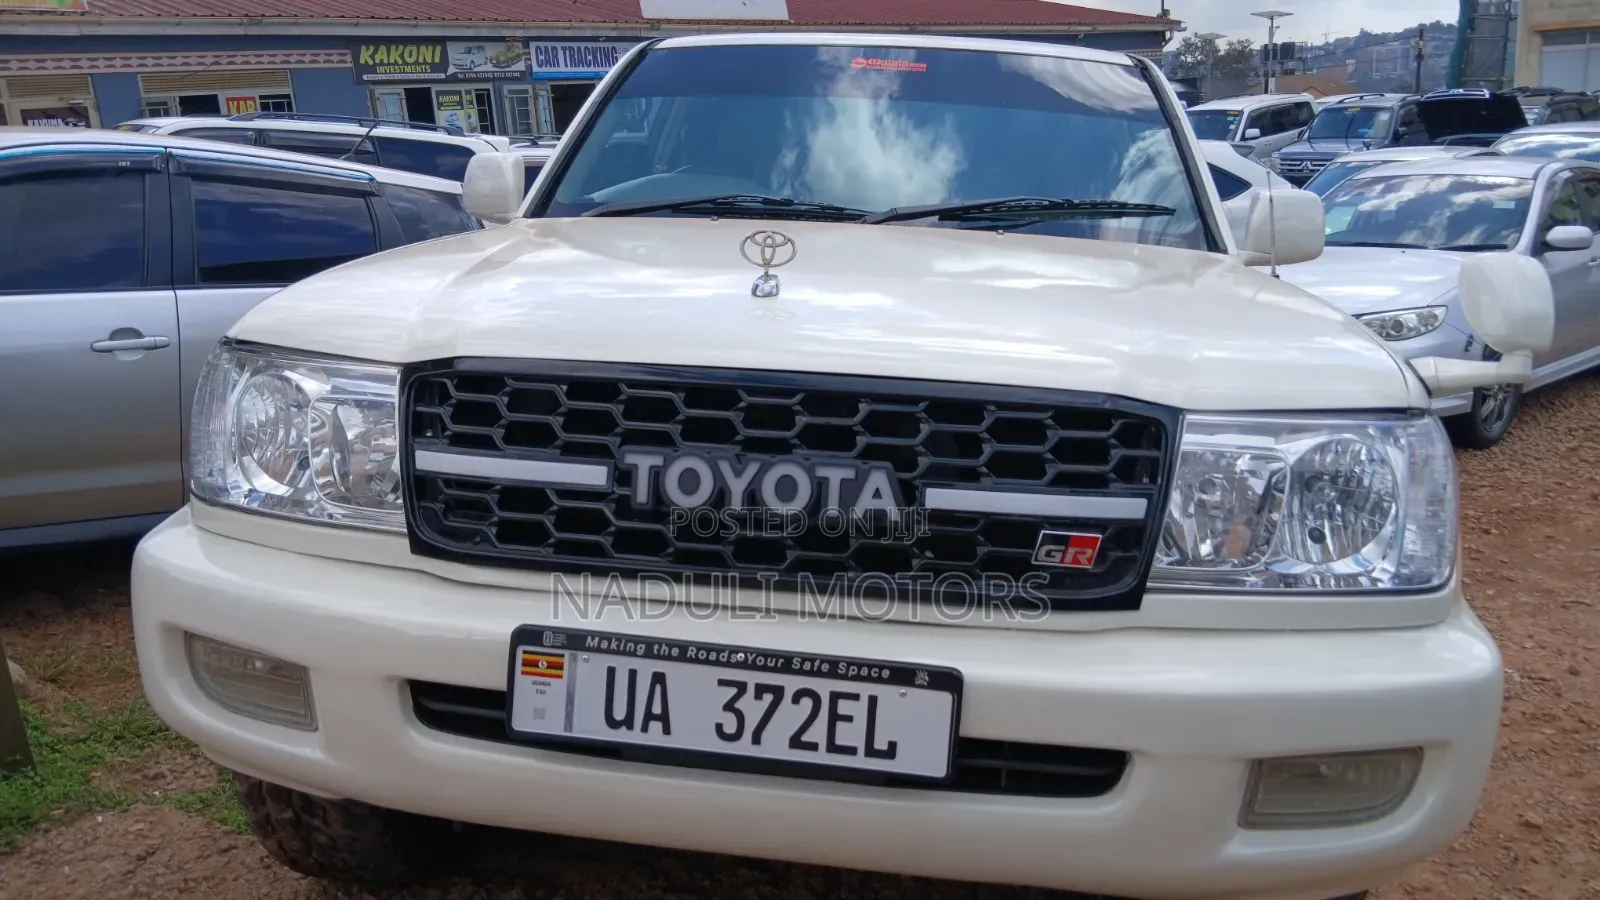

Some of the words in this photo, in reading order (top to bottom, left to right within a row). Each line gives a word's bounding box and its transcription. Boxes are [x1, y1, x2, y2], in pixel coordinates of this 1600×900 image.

[360, 45, 442, 65] KAKONI
[534, 45, 560, 69] CAR
[561, 45, 619, 69] TRACKING
[376, 65, 431, 74] INVESTMENTS
[623, 453, 900, 522] TOYOTA
[1037, 544, 1094, 565] GR
[585, 635, 646, 656] Making
[652, 643, 680, 657] the
[686, 646, 740, 663] Roads
[747, 652, 785, 668] Your
[791, 657, 830, 673] Safe
[837, 662, 890, 678] Space
[604, 665, 671, 736] UA
[714, 678, 898, 760] 372EL
